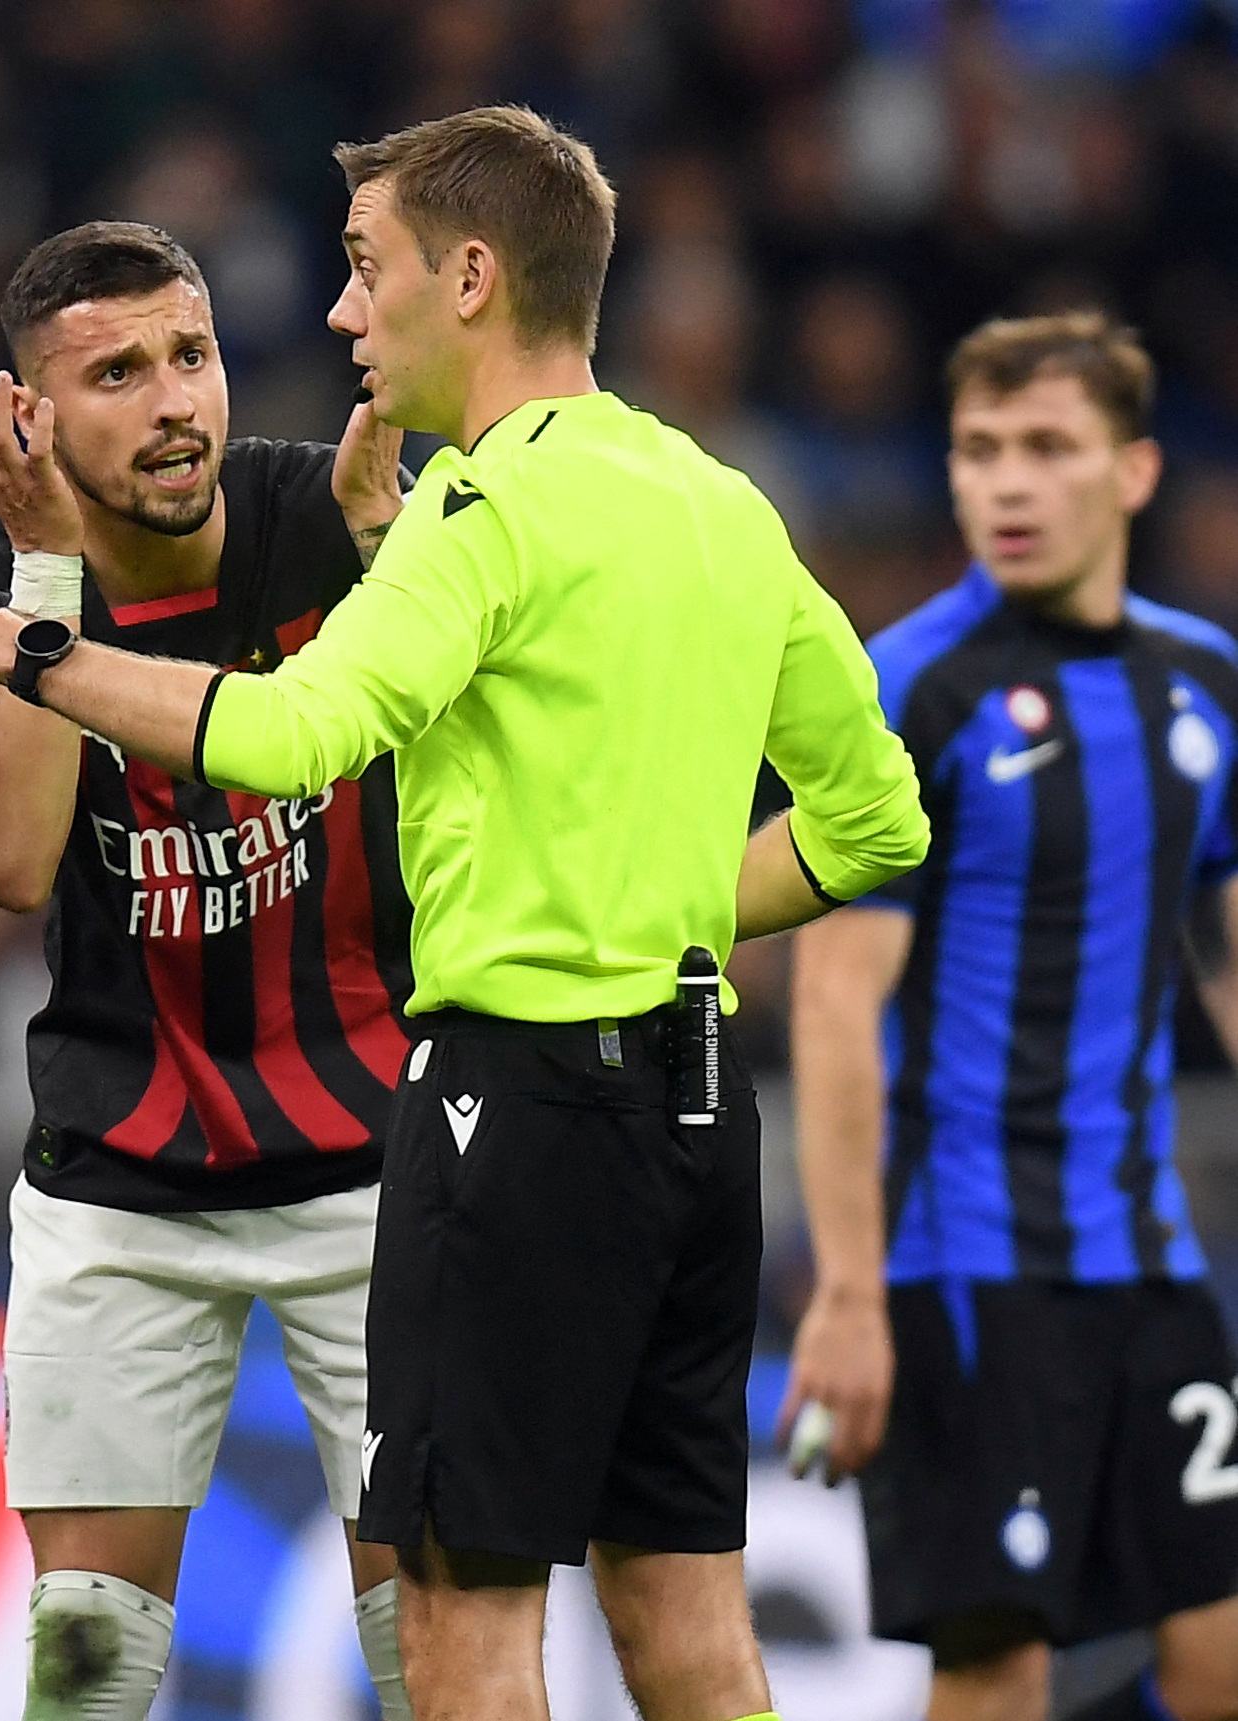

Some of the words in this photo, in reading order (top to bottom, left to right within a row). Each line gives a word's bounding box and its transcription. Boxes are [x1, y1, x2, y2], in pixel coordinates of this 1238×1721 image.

[129, 887, 189, 937] FLY
[204, 838, 310, 936] BETTER
[705, 993, 718, 1036] SPRAY
[705, 1037, 719, 1109] VANISHING
[1168, 1376, 1238, 1505] 2
